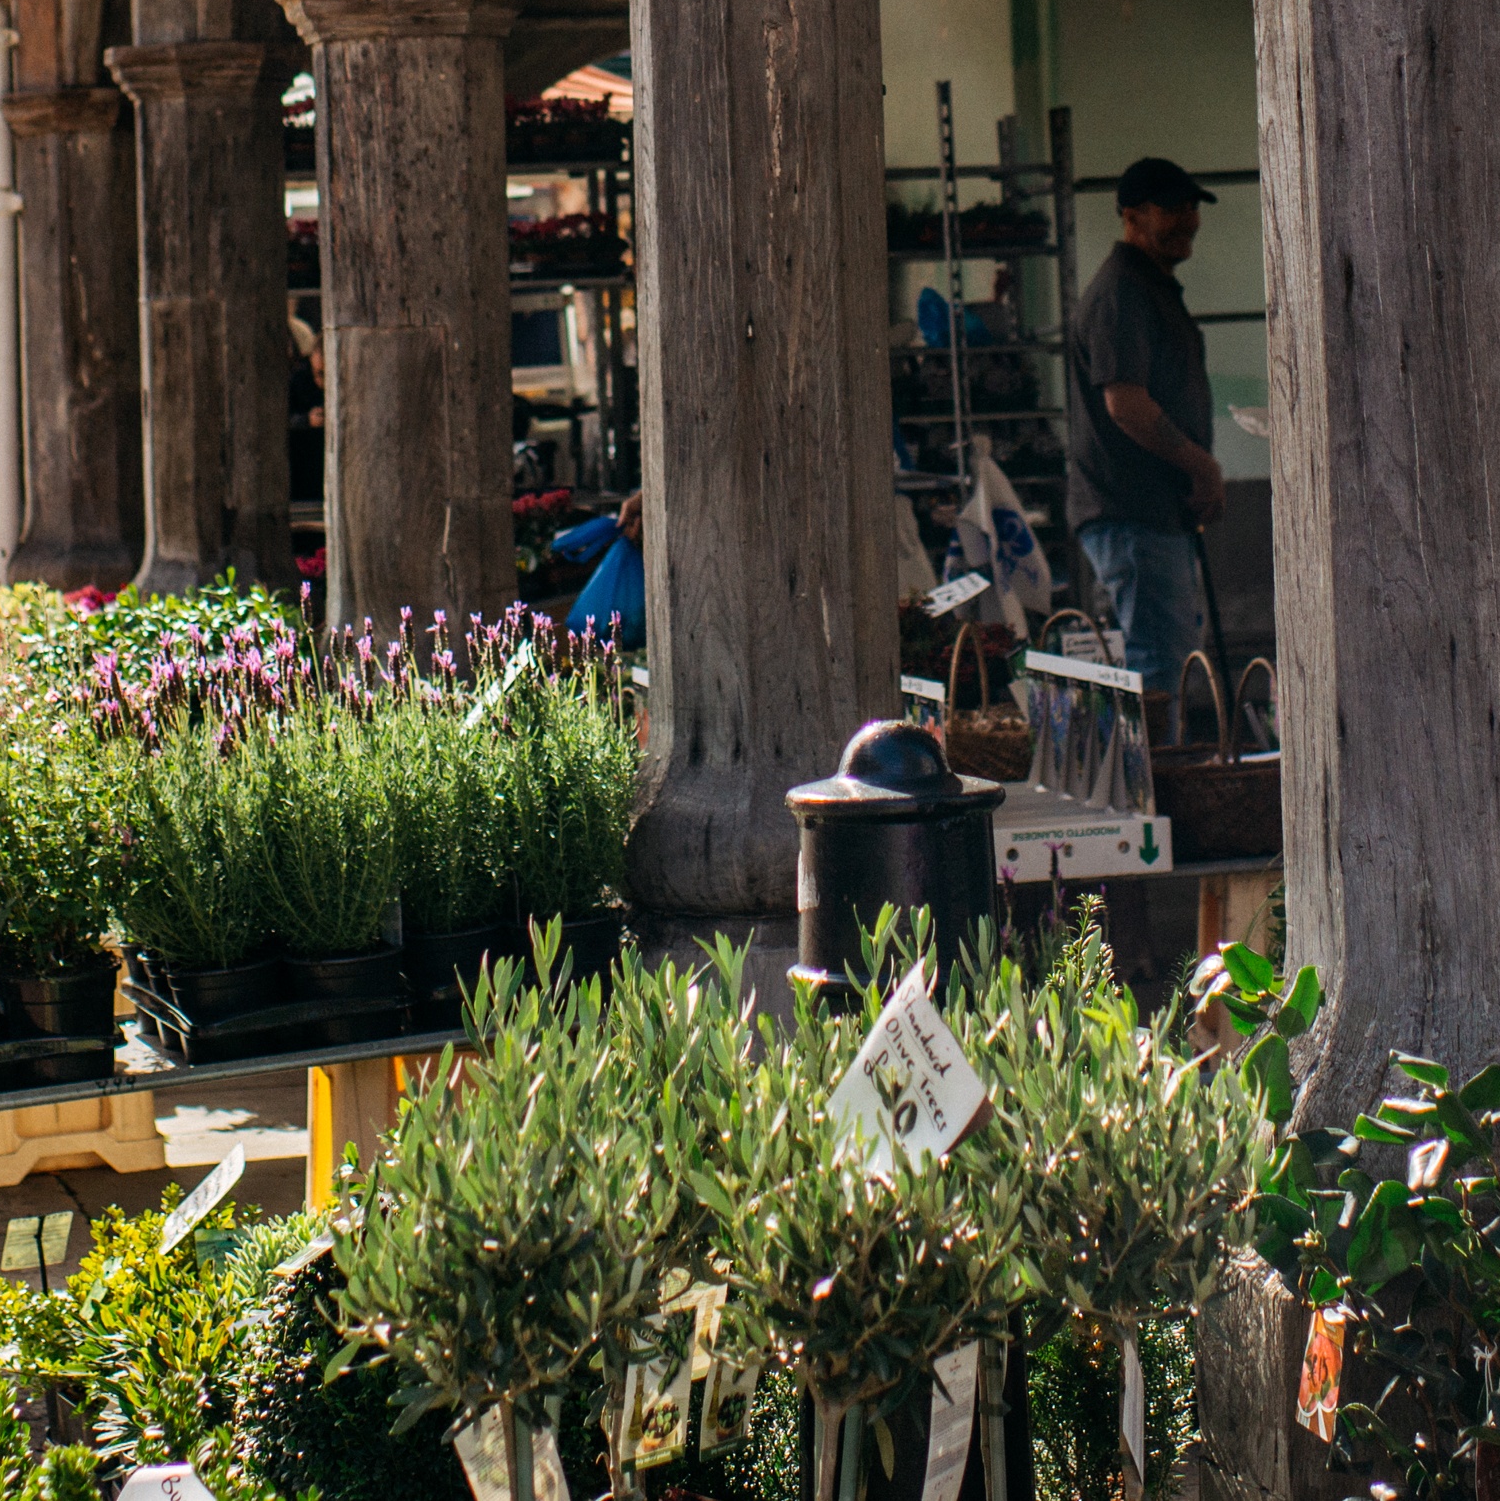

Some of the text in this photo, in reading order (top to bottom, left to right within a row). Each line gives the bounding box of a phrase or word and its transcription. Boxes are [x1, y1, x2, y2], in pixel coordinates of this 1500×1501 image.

[1066, 826, 1121, 839] PRODOTTO
[884, 1017, 947, 1134] Olive Trees
[900, 984, 952, 1078] Standard
